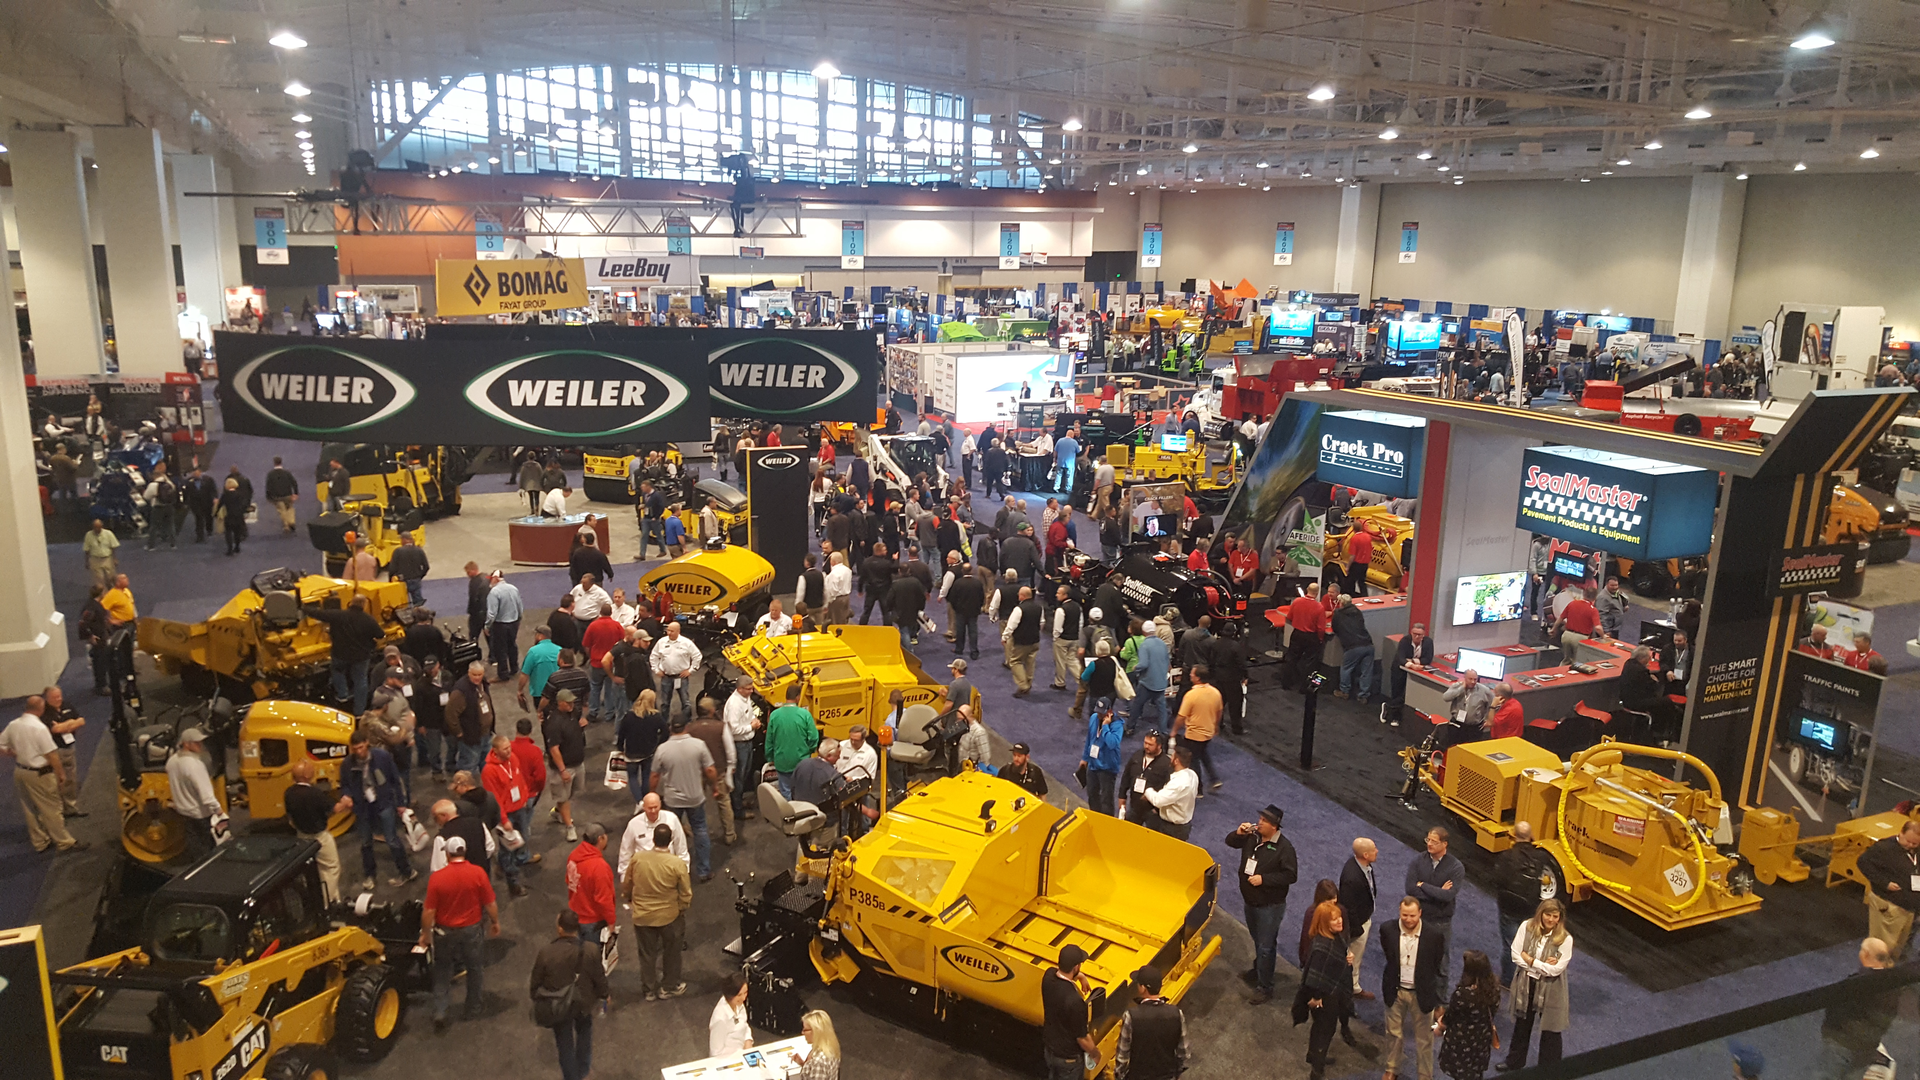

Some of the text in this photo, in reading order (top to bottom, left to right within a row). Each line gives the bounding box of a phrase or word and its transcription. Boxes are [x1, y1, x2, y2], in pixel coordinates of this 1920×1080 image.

[598, 258, 670, 283] LeeBoy
[497, 270, 568, 296] BOMAG
[499, 300, 547, 310] FAYAT GROUP
[720, 363, 827, 389] WEILER
[260, 373, 374, 404] WEILER
[507, 380, 647, 407] WEILER
[1322, 433, 1404, 464] Crack Pro
[765, 457, 792, 465] WEILER
[1525, 465, 1643, 512] SealMaster
[1522, 508, 1641, 545] Pavement Products & Equipment
[1289, 531, 1321, 543] AFERIDE
[664, 582, 712, 597] WEILER
[1709, 657, 1757, 674] THE SMART
[1707, 668, 1756, 684] CHOICE FOR
[1705, 678, 1755, 695] PAVEMENT
[1803, 674, 1860, 697] TRAFFIC PAINTS
[1703, 688, 1753, 703] MAINTENANCE
[819, 708, 841, 720] P265
[328, 745, 347, 757] CAT
[1670, 873, 1687, 888] 3257
[1674, 869, 1685, 878] HOT
[954, 951, 1000, 976] WEILER
[101, 1045, 129, 1063] CAT
[240, 1025, 266, 1068] CAT
